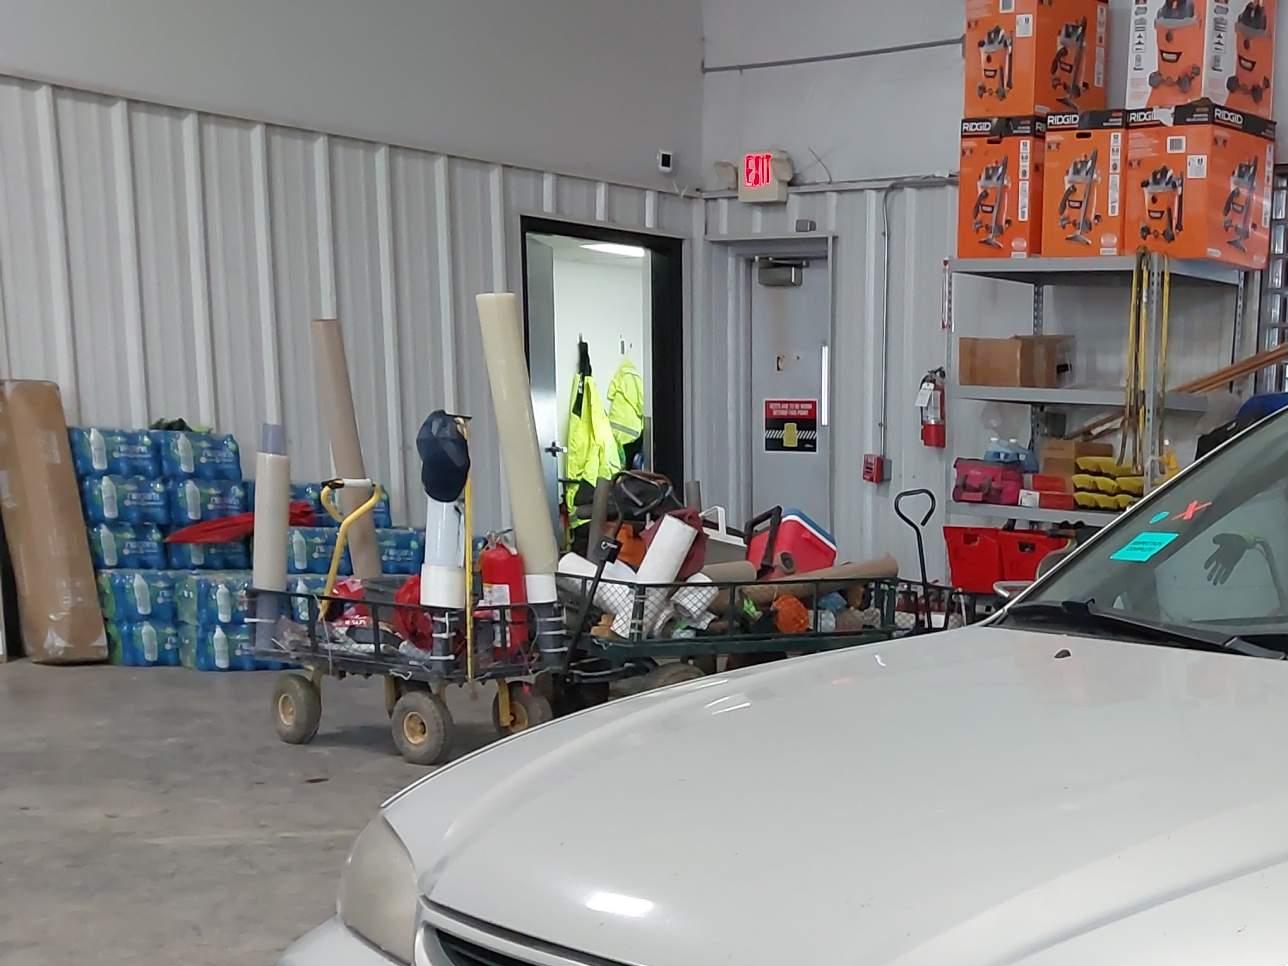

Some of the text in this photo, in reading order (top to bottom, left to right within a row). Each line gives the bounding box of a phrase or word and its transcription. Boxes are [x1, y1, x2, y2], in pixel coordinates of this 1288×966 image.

[1047, 114, 1080, 125] RIDGID
[1214, 108, 1244, 123] RIDGID
[962, 121, 992, 132] RIDGID
[745, 154, 772, 185] EXIT
